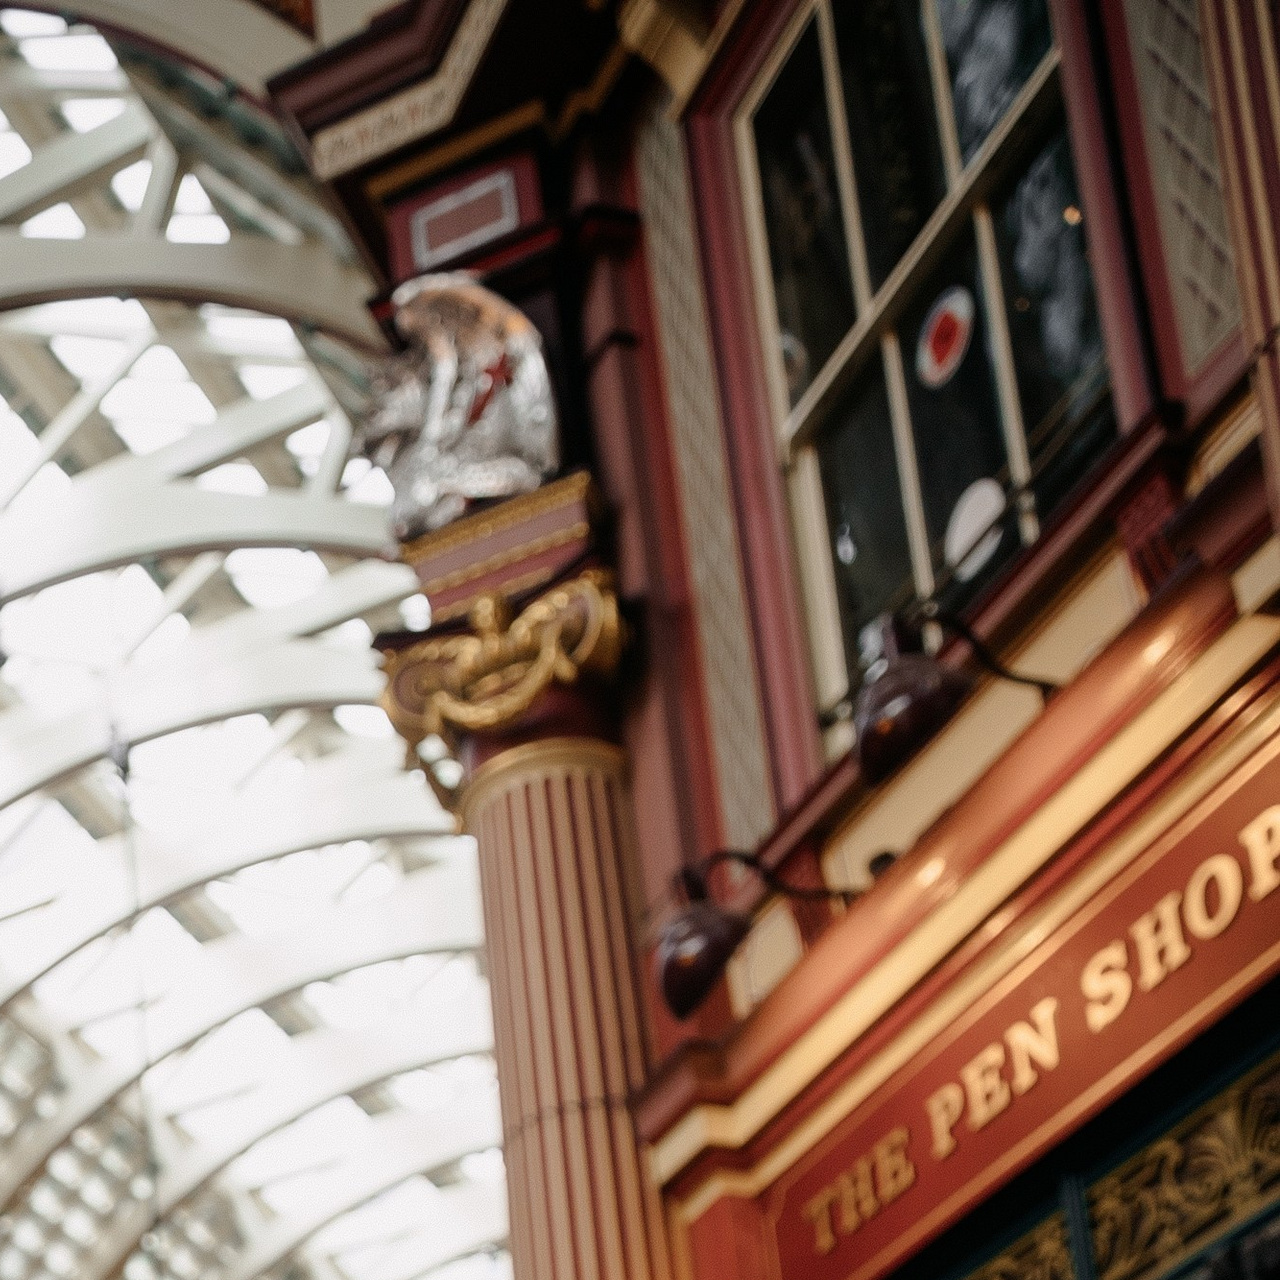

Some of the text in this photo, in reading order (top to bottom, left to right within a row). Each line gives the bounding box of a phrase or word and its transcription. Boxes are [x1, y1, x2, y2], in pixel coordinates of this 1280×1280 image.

[803, 803, 1280, 1253] THE PEN SHOP
